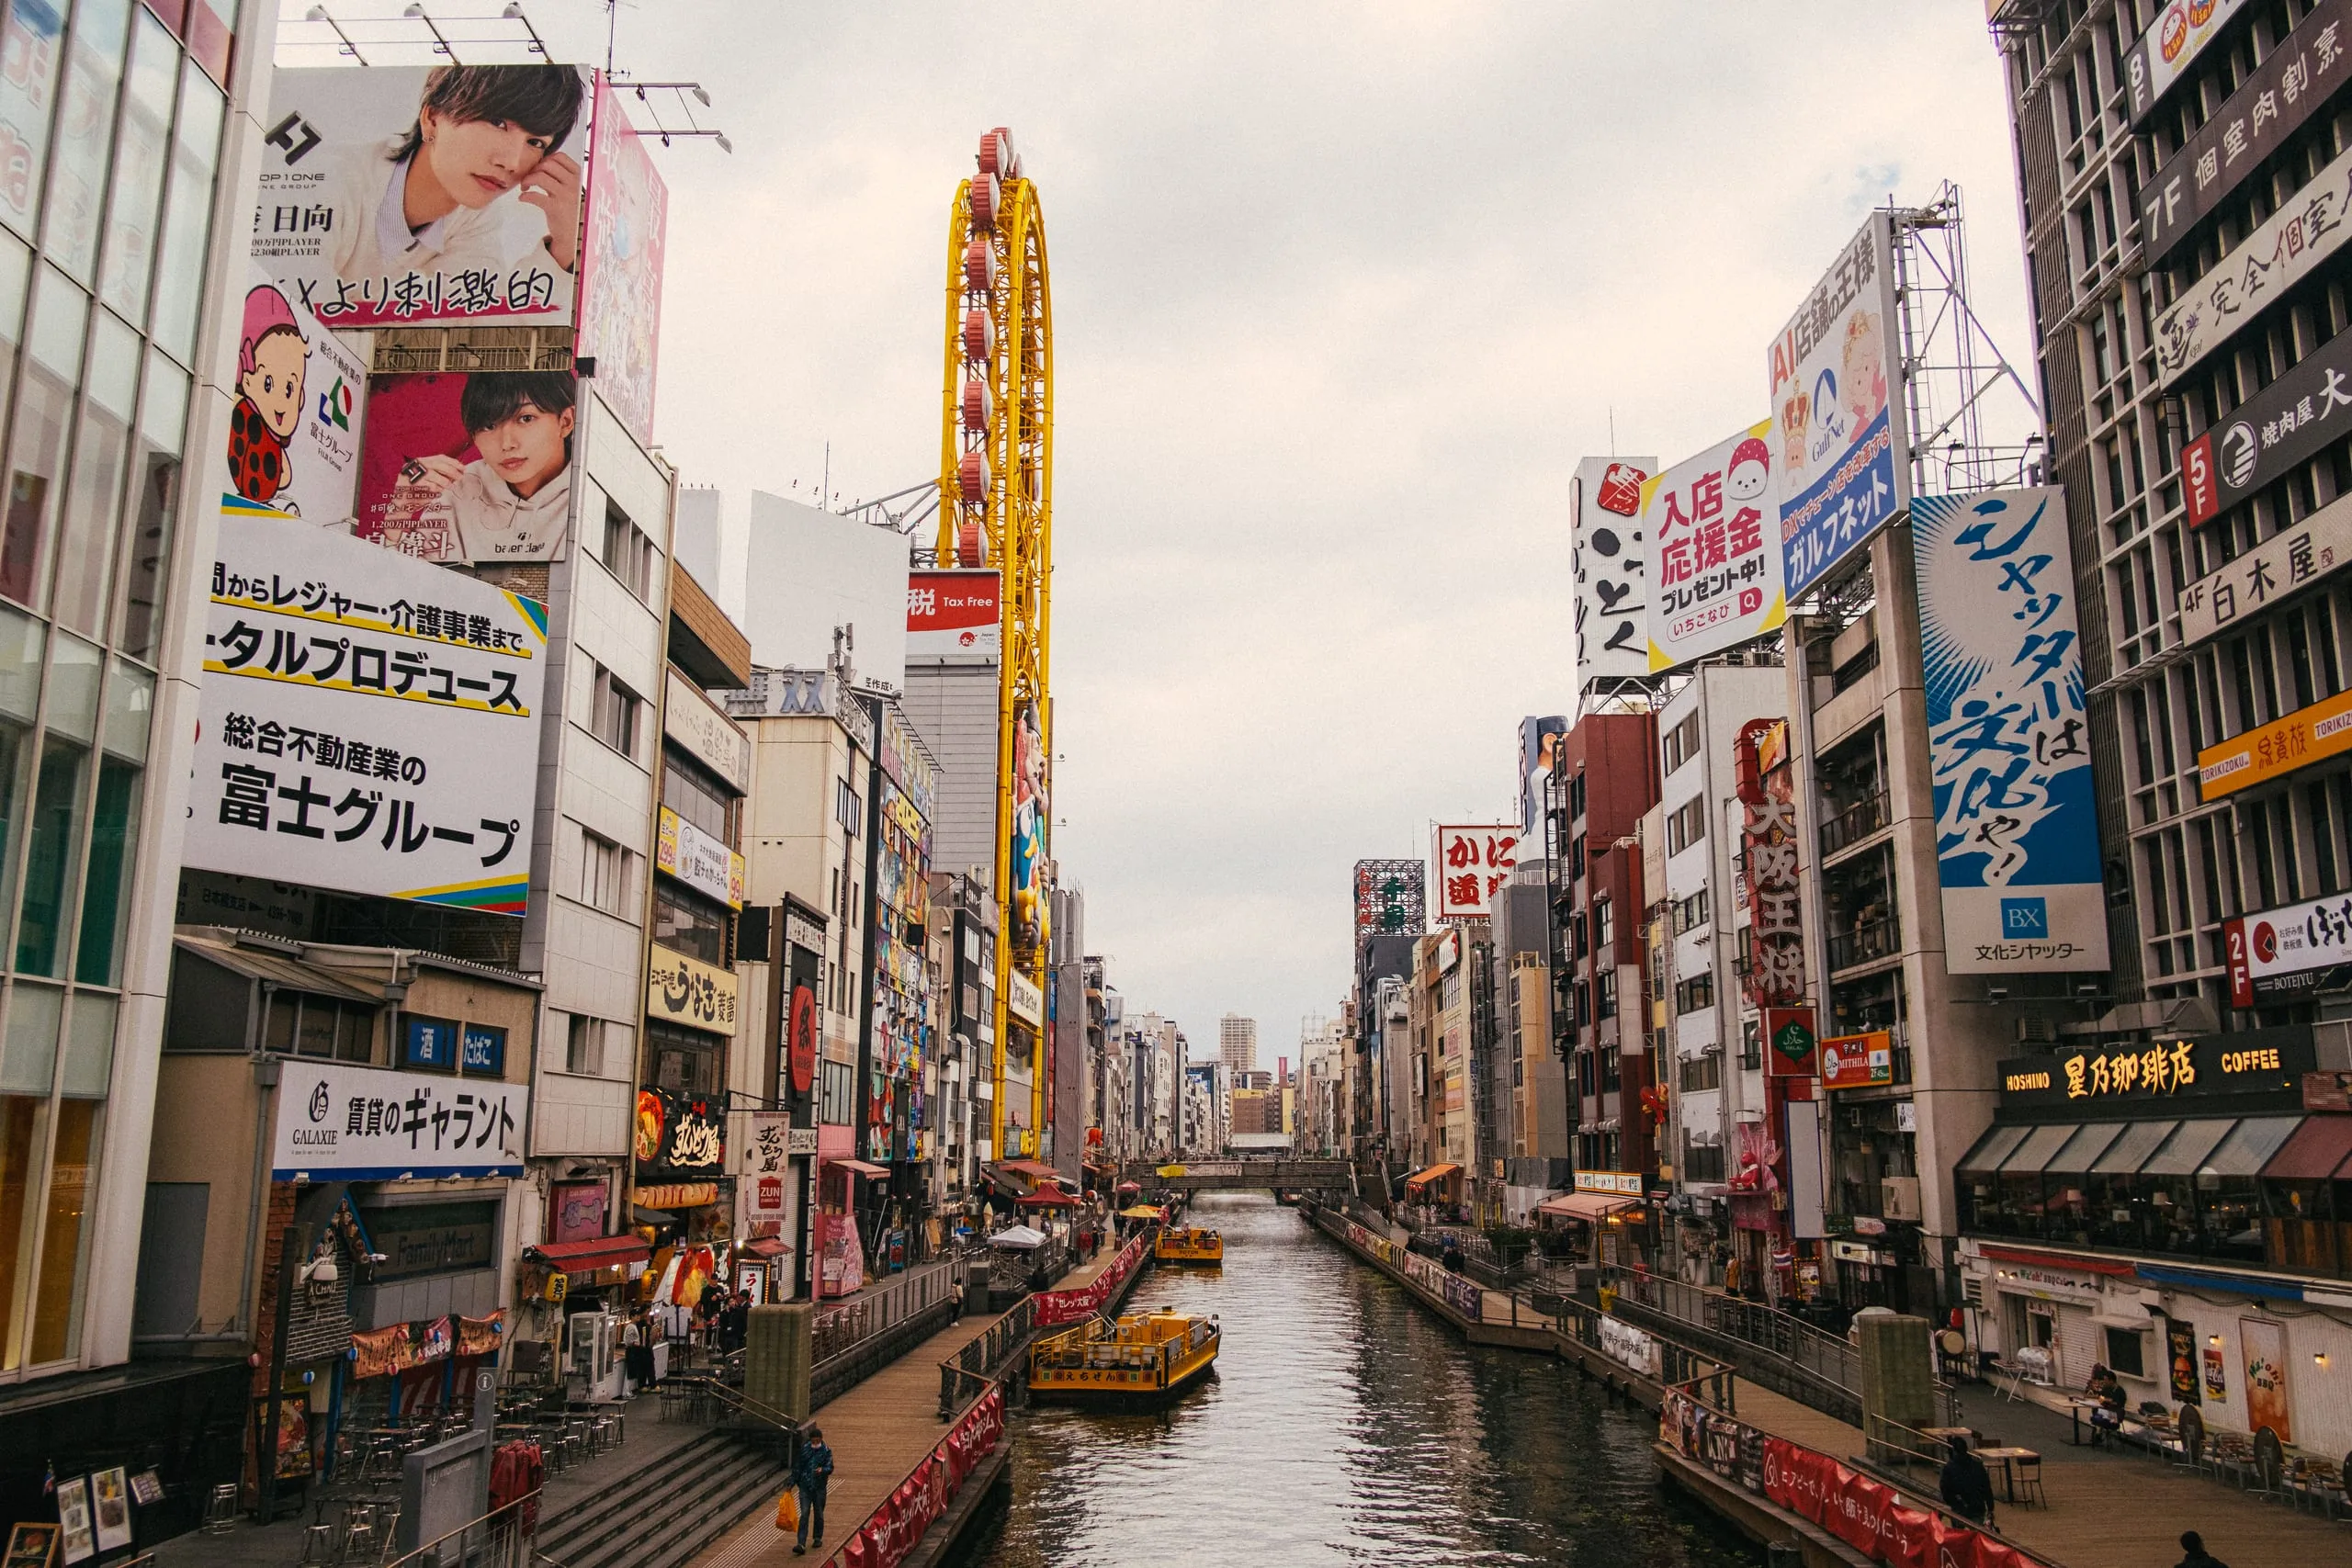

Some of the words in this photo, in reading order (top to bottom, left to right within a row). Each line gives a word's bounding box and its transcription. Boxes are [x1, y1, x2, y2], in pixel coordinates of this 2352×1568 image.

[2129, 52, 2144, 113] 8F
[2145, 175, 2181, 243] 7F
[1772, 230, 1876, 395] AI店舗の王様
[311, 422, 353, 462] 富士グループ
[2261, 396, 2314, 450] 焼肉屋
[1659, 469, 1723, 540] 入店
[1781, 424, 1891, 544] DXでチェーン店を改革する
[2189, 446, 2206, 515] 5F
[1661, 506, 1762, 589] 応援金
[1790, 478, 1888, 591] ガルフネット
[944, 597, 964, 607] Tax
[967, 597, 993, 607] Free
[1661, 554, 1766, 616] プレゼント中!
[2184, 584, 2204, 613] 4F
[2212, 532, 2318, 626] 白木屋
[1673, 604, 1730, 637] いちこなび
[206, 620, 523, 712] タルプロデュース
[223, 712, 427, 785] 総合不動産業の
[2201, 756, 2245, 782] TORIKIZOKU
[2258, 722, 2307, 770] 鳥貴族
[2315, 713, 2352, 738] TORIKIZ
[219, 762, 521, 868] 富士グループ
[1447, 835, 1516, 868] かに
[1743, 793, 1804, 995] 大阪王将
[2008, 909, 2041, 929] BX
[664, 961, 717, 1021] うなぎ
[2231, 933, 2245, 994] 2F
[2274, 972, 2313, 990] BOTEJYU
[421, 1028, 435, 1060] 酒
[463, 1035, 492, 1067] たばこ
[1838, 1057, 1869, 1068] MITHILA
[2007, 1072, 2050, 1091] HOSHINO
[2064, 1040, 2196, 1099] 星乃珈琲店
[2222, 1047, 2280, 1073] COFFEE
[345, 1087, 515, 1152] 賃貸のギャラント
[760, 1187, 781, 1198] ZUN
[397, 1231, 475, 1268] FamilyMart
